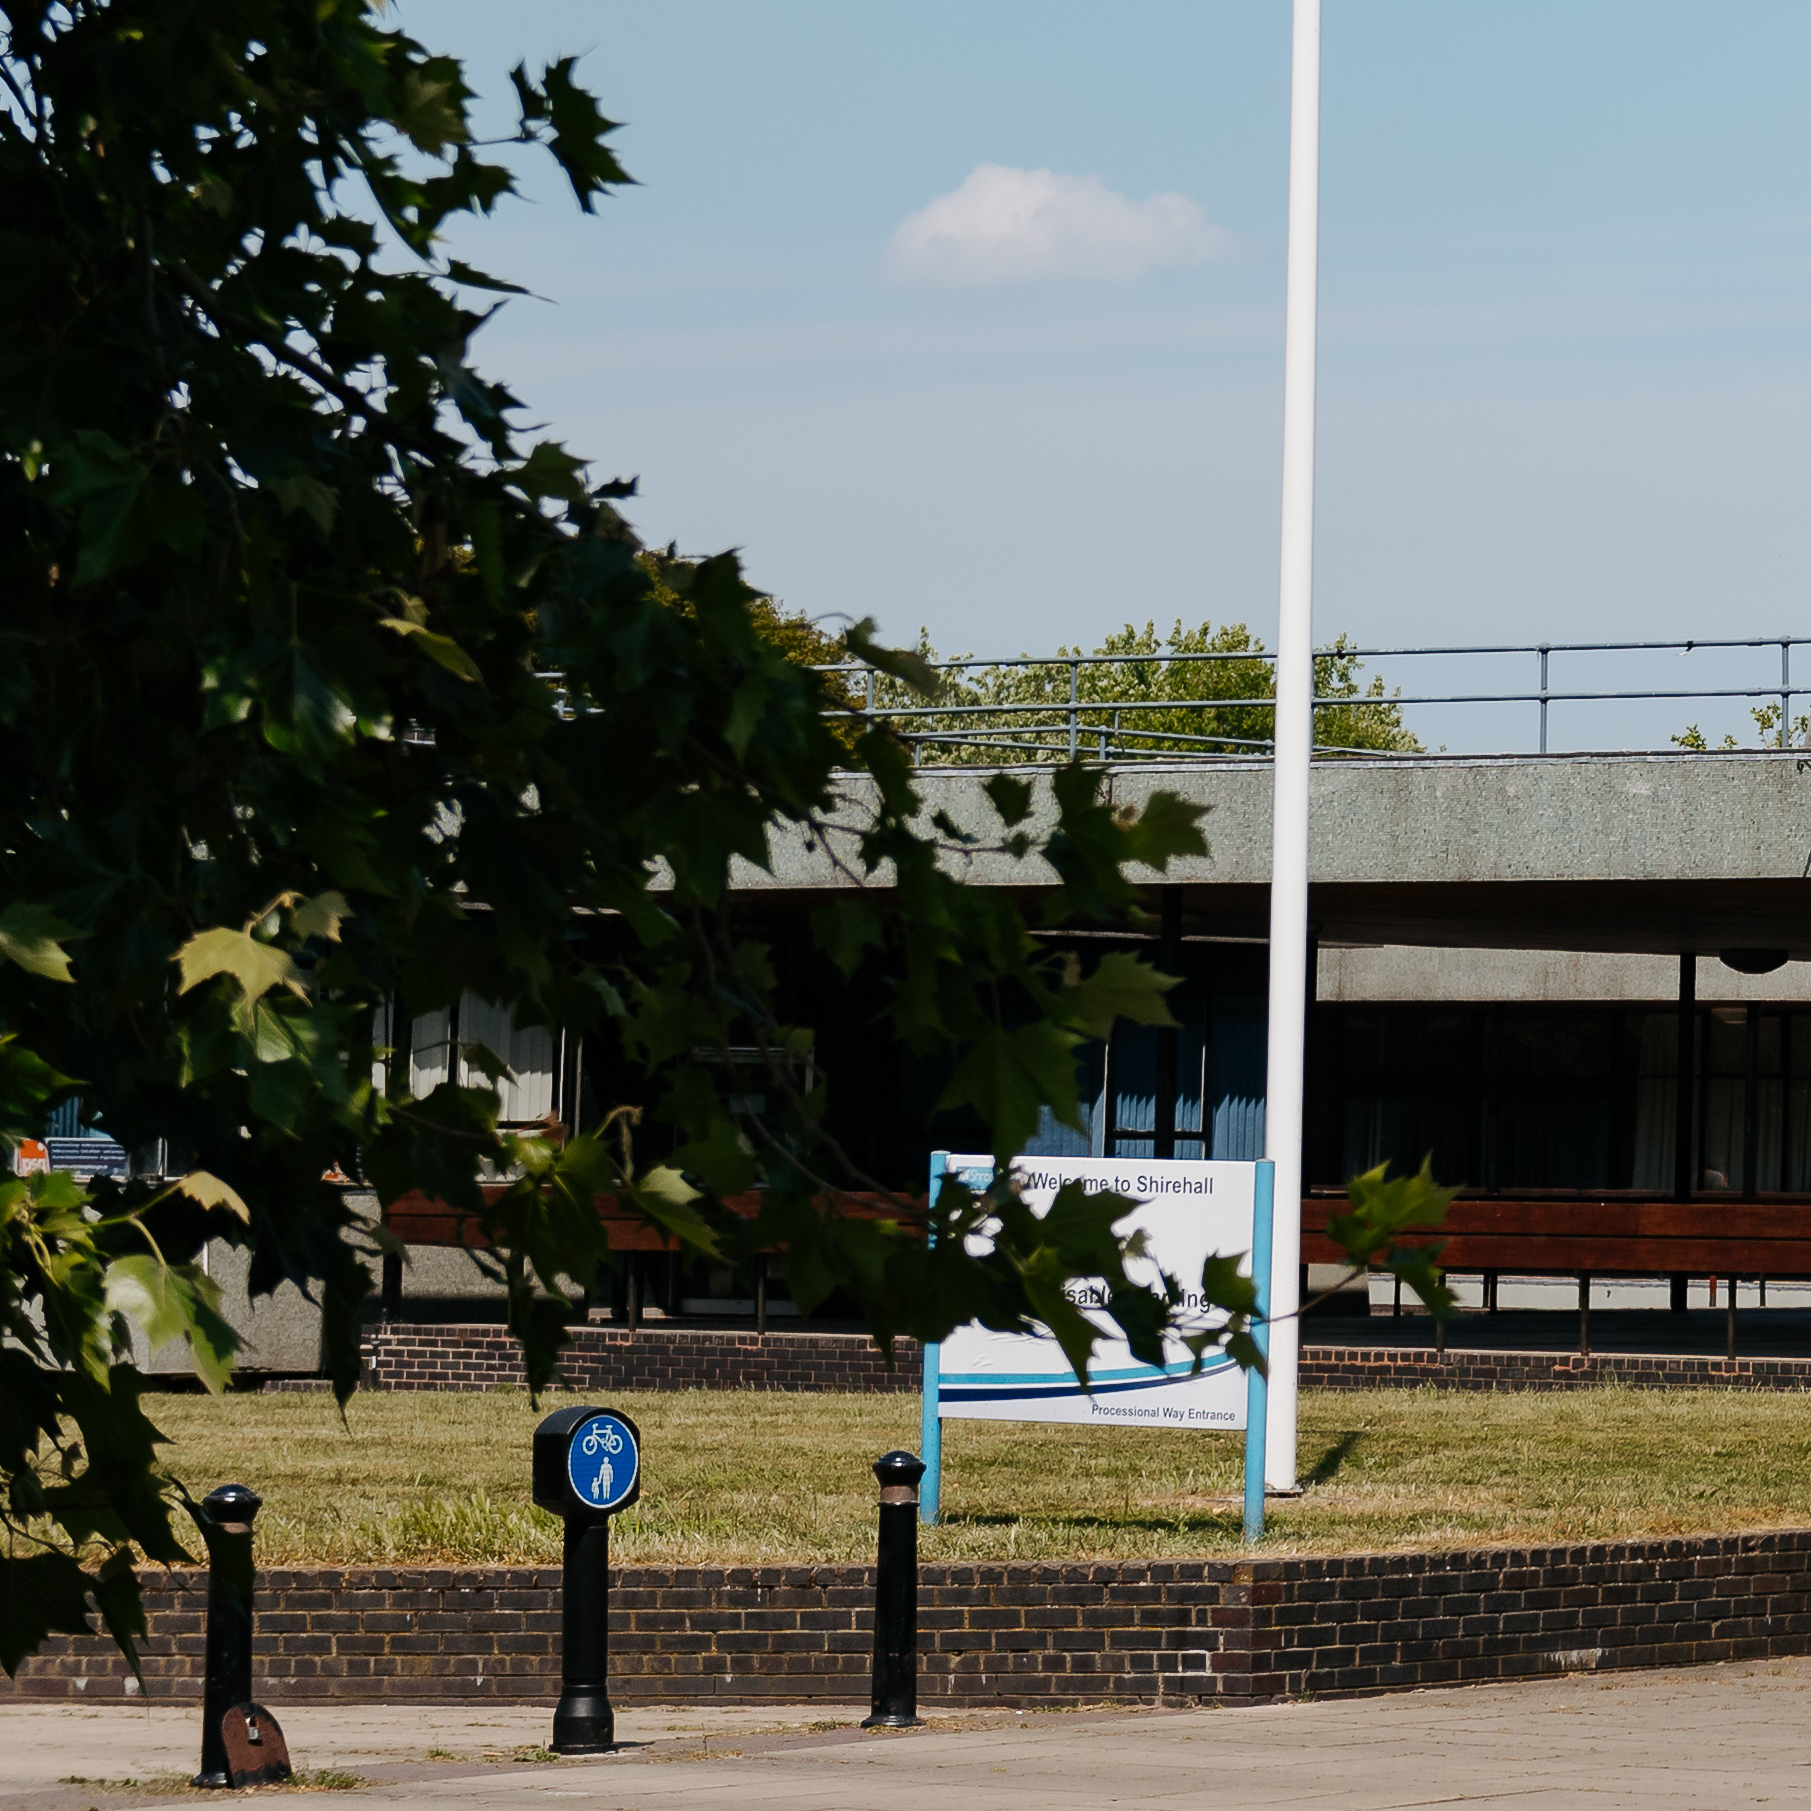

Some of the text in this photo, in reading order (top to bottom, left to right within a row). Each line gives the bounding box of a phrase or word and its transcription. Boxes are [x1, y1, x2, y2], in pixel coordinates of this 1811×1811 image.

[1027, 1172, 1214, 1195] Welcme to Shirehall
[1091, 1403, 1236, 1422] Processional Way Entrance
